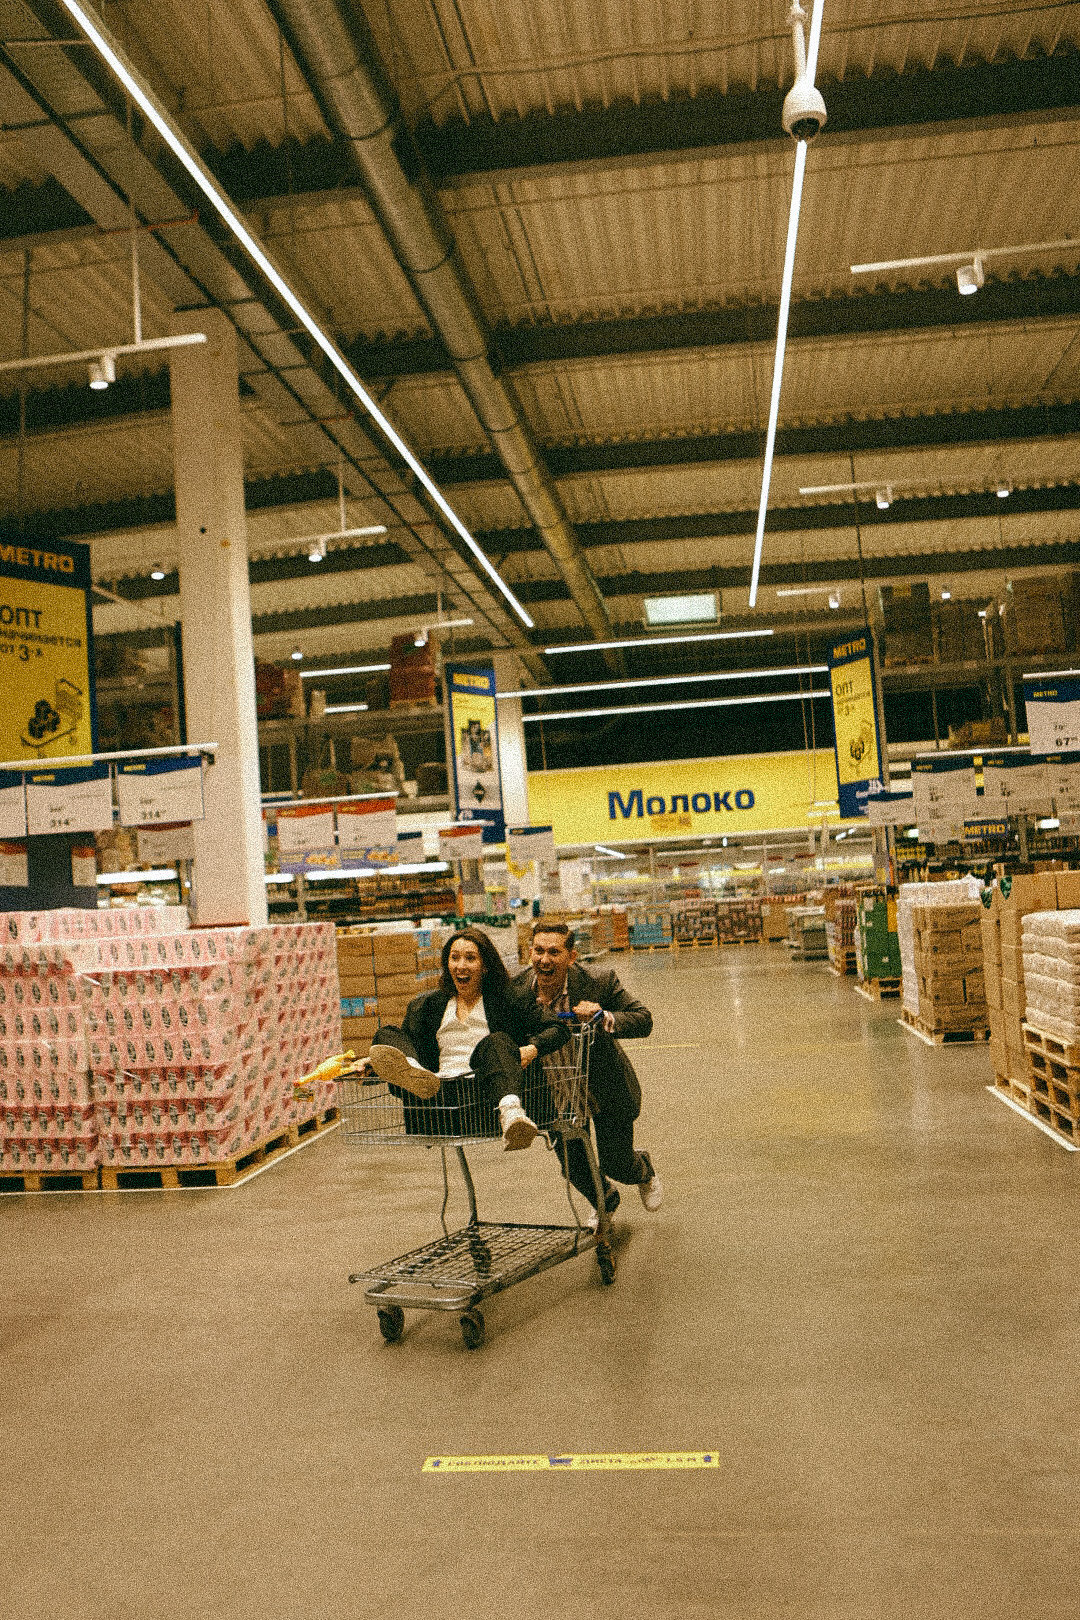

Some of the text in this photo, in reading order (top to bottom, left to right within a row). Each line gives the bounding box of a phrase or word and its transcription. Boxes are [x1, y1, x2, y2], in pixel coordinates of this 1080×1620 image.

[0, 544, 74, 573] METRO
[833, 638, 866, 659] METRO
[608, 788, 756, 820] Молоко
[964, 823, 1005, 836] METRO
